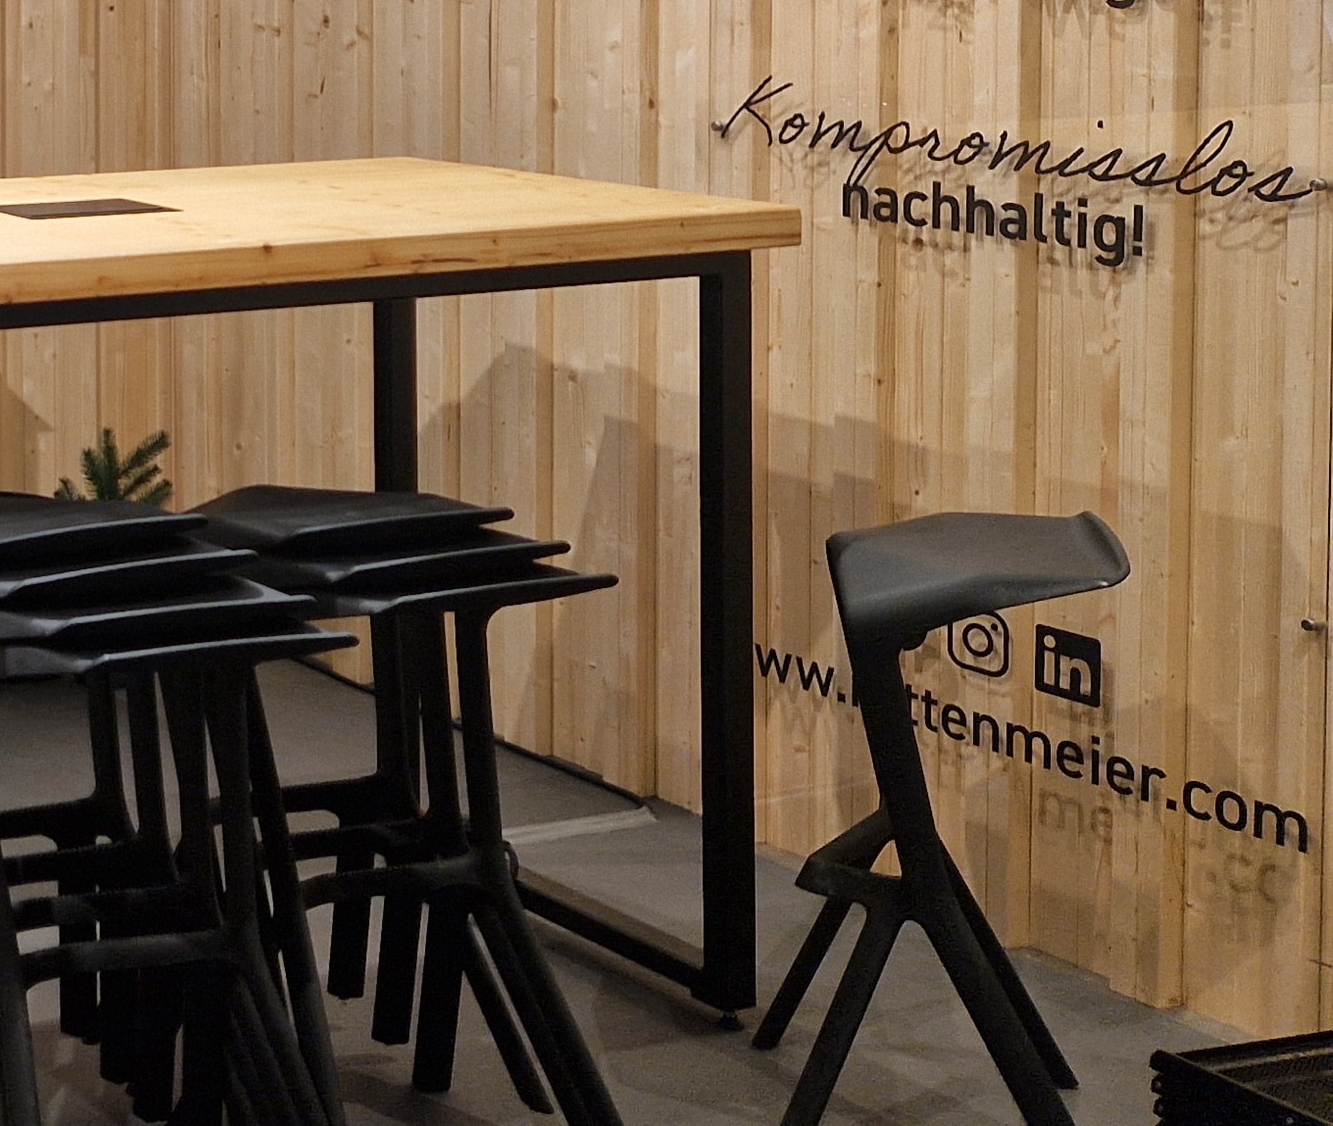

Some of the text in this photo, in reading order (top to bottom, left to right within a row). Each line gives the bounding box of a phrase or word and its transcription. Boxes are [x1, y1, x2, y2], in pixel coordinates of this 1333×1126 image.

[721, 74, 1313, 203] Kompromisslos
[842, 178, 1146, 267] nachhaltig!
[754, 642, 1310, 854] ww.ttenmeier.com
